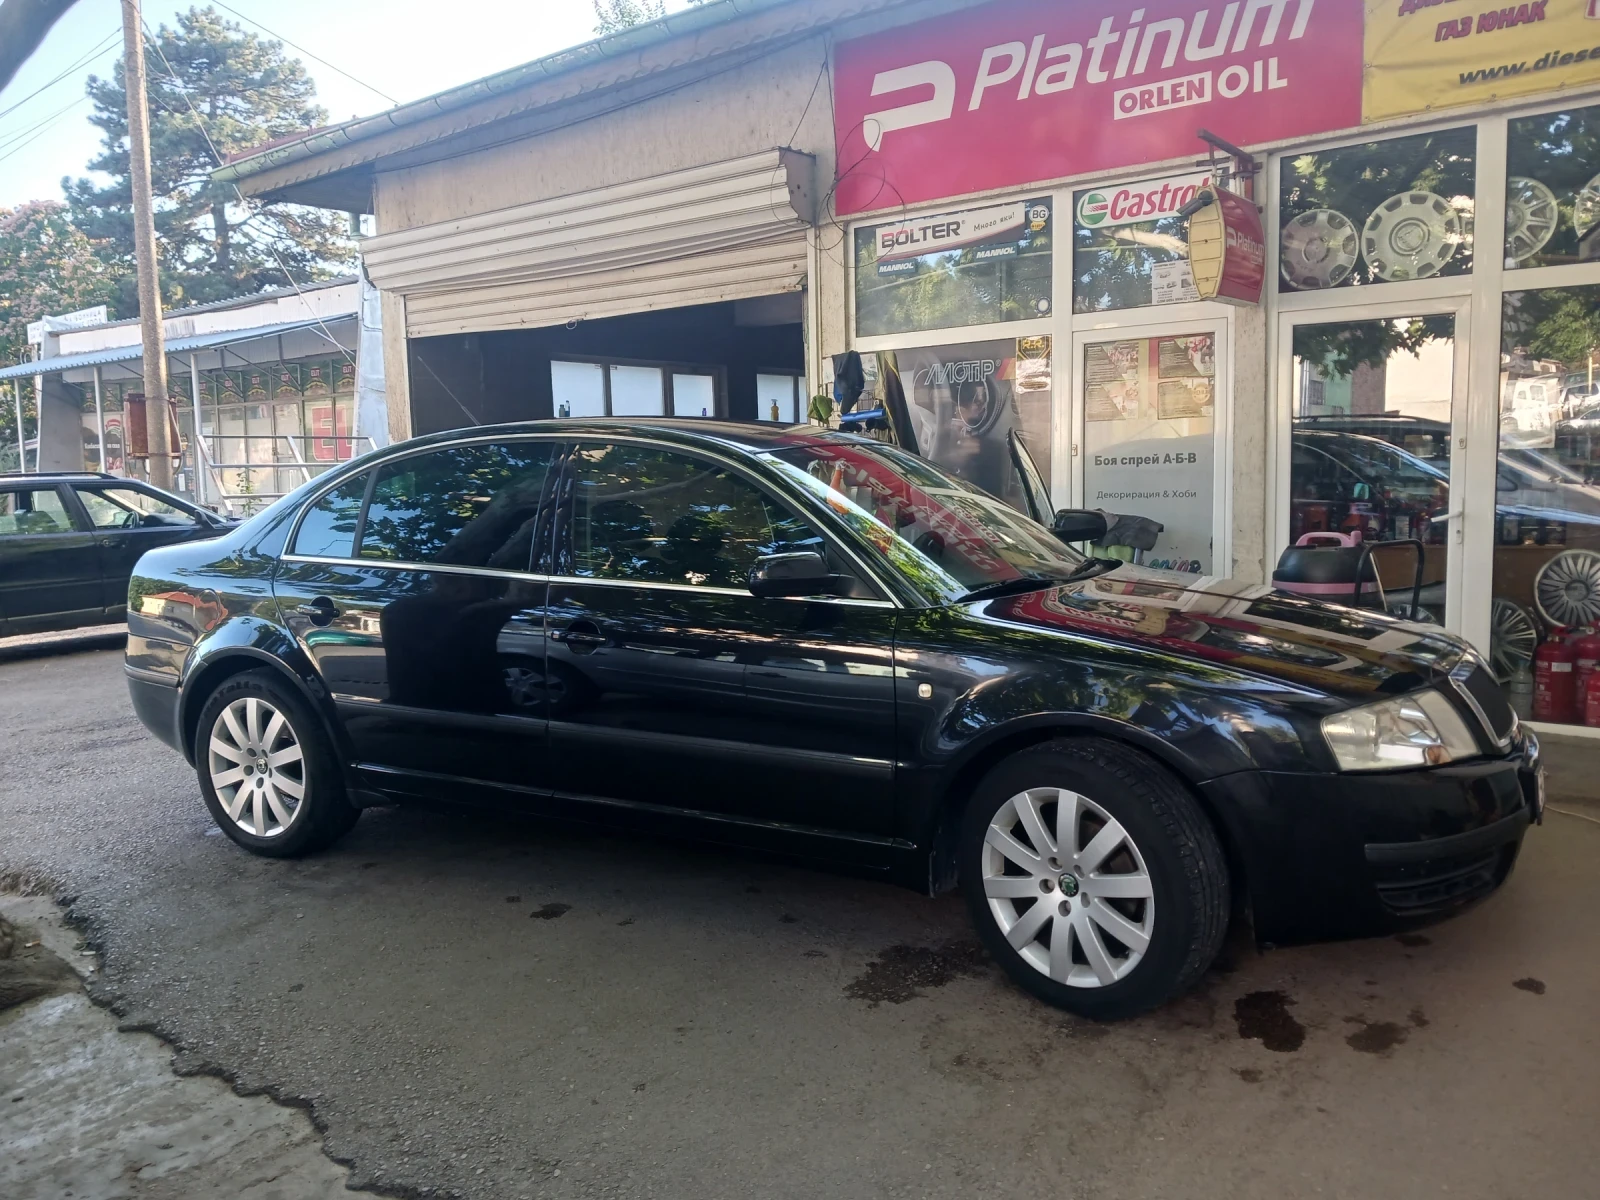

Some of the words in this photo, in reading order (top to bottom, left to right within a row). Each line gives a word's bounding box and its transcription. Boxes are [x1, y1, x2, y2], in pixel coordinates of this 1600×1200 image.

[1434, 16, 1474, 42] ГАЗ
[1476, 0, 1548, 35] ЮНАК
[967, 0, 1315, 111] Platinum
[1118, 76, 1205, 114] ORLEN
[1217, 56, 1288, 99] OIL
[1032, 209, 1046, 219] BG
[881, 220, 961, 249] BOLTER
[975, 247, 1016, 259] MANNOL
[878, 262, 914, 273] MANNOL
[1094, 455, 1118, 466] Боя
[1120, 453, 1160, 468] спрей
[1096, 490, 1160, 500] Декорирация
[1162, 490, 1170, 498] &
[1171, 490, 1197, 498] Хоби
